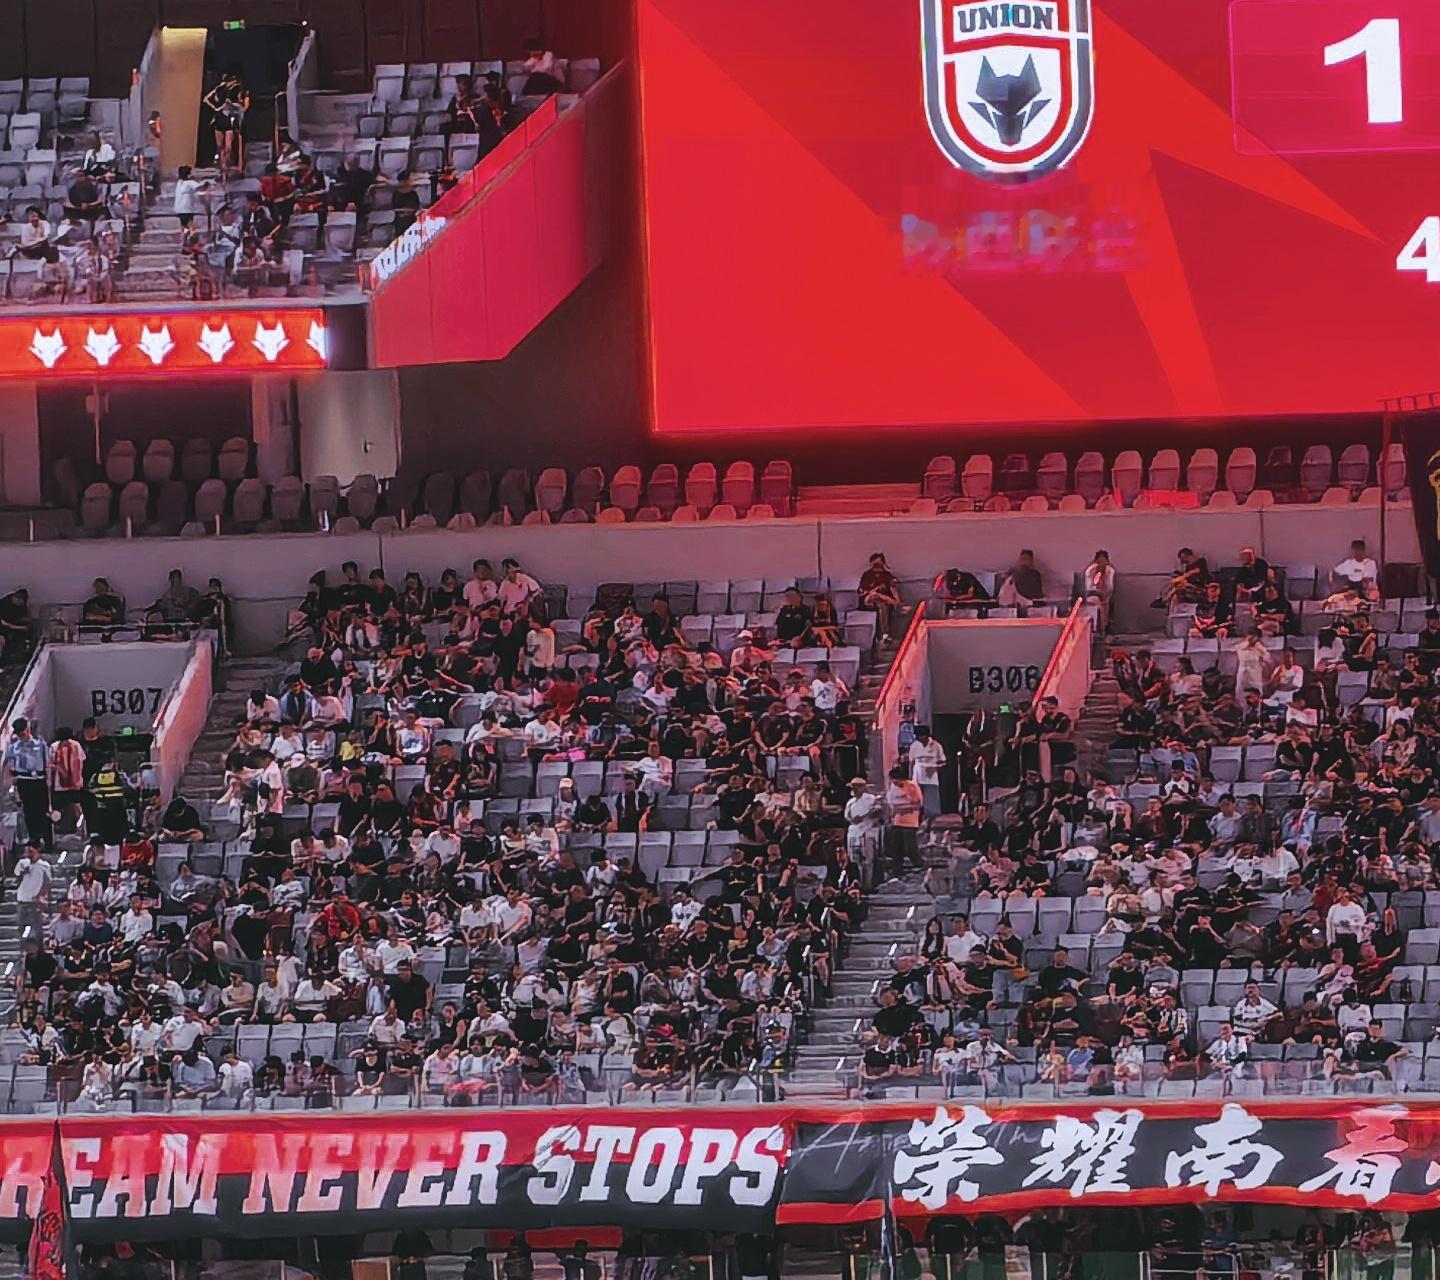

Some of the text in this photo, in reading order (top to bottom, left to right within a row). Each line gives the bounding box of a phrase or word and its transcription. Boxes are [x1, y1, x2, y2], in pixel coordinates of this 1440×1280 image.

[957, 3, 1054, 34] UNION
[1324, 18, 1403, 124] 1
[91, 688, 162, 717] B307
[242, 1126, 507, 1216] NEVER
[526, 1122, 785, 1208] STOPS
